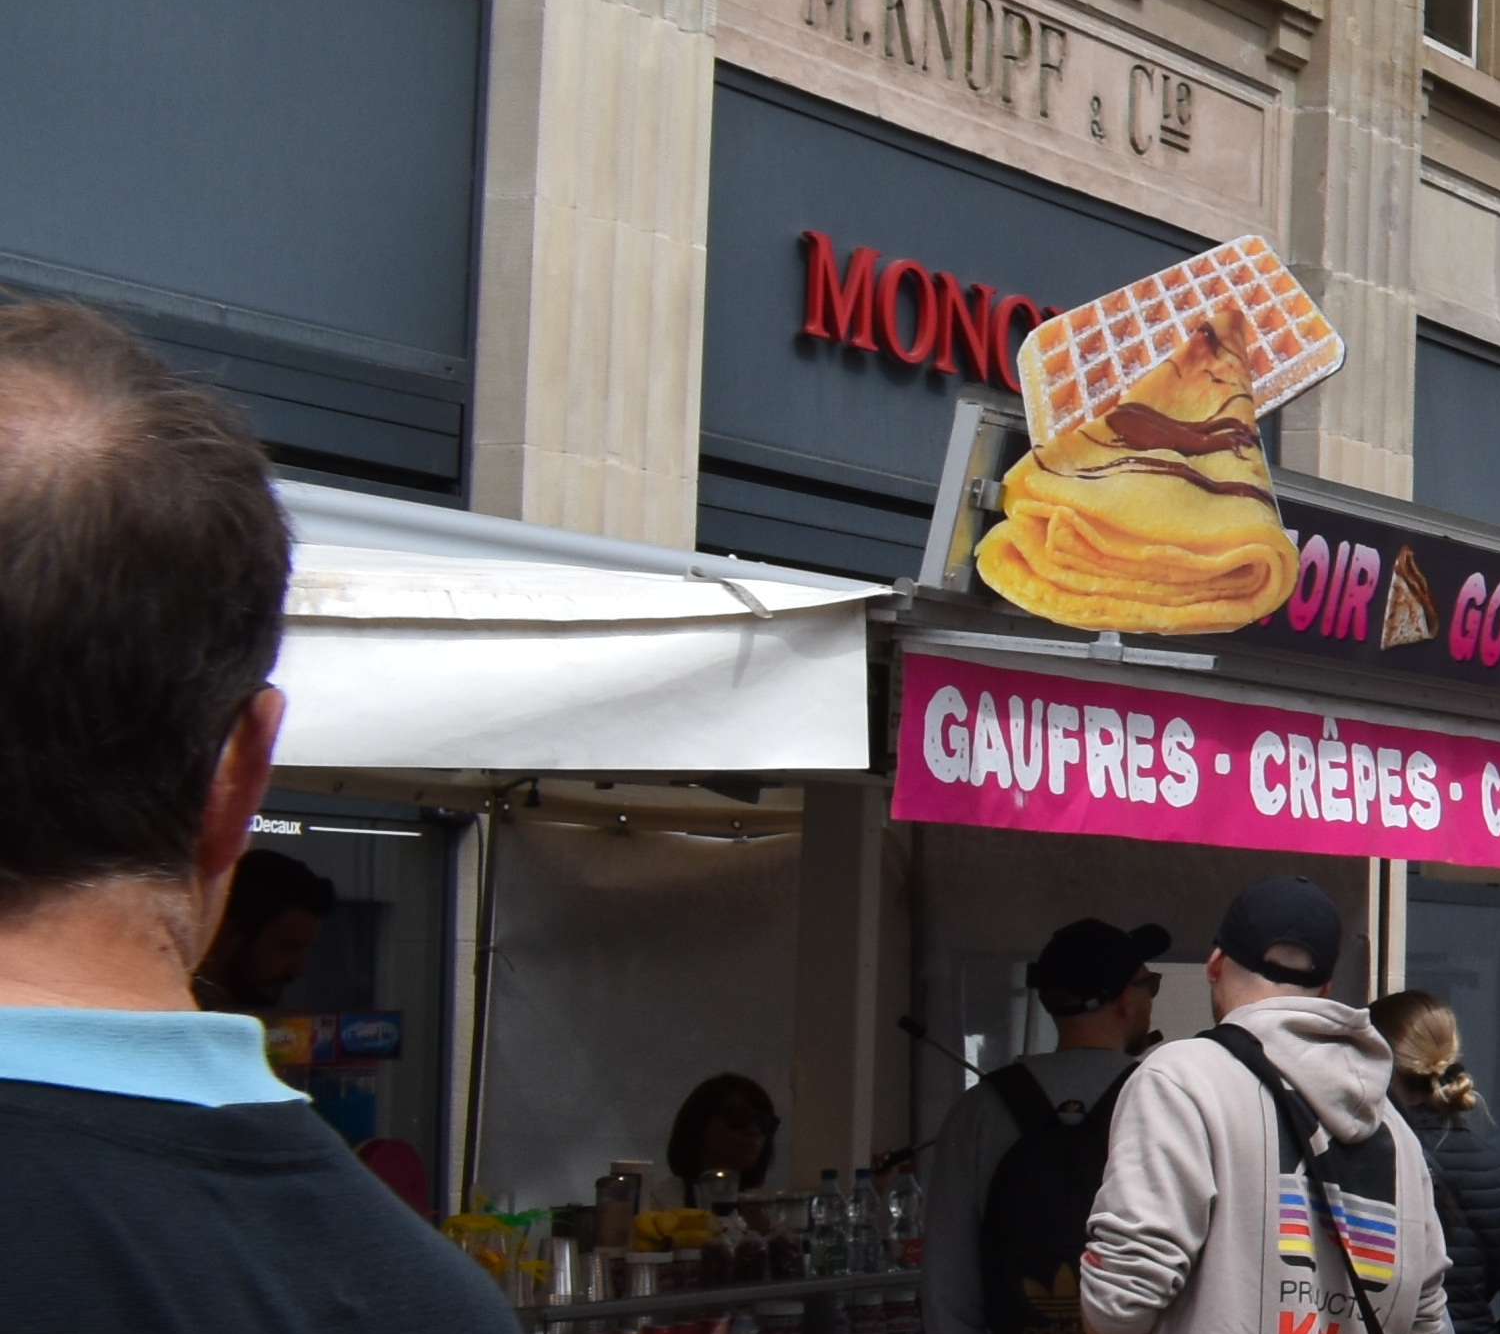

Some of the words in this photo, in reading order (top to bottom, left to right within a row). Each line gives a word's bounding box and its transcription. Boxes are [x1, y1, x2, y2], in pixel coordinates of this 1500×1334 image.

[802, 230, 1060, 394] MONO
[1259, 528, 1381, 642] OIR
[923, 685, 1199, 808] GAUFRES
[1248, 717, 1442, 831] CRÊPES
